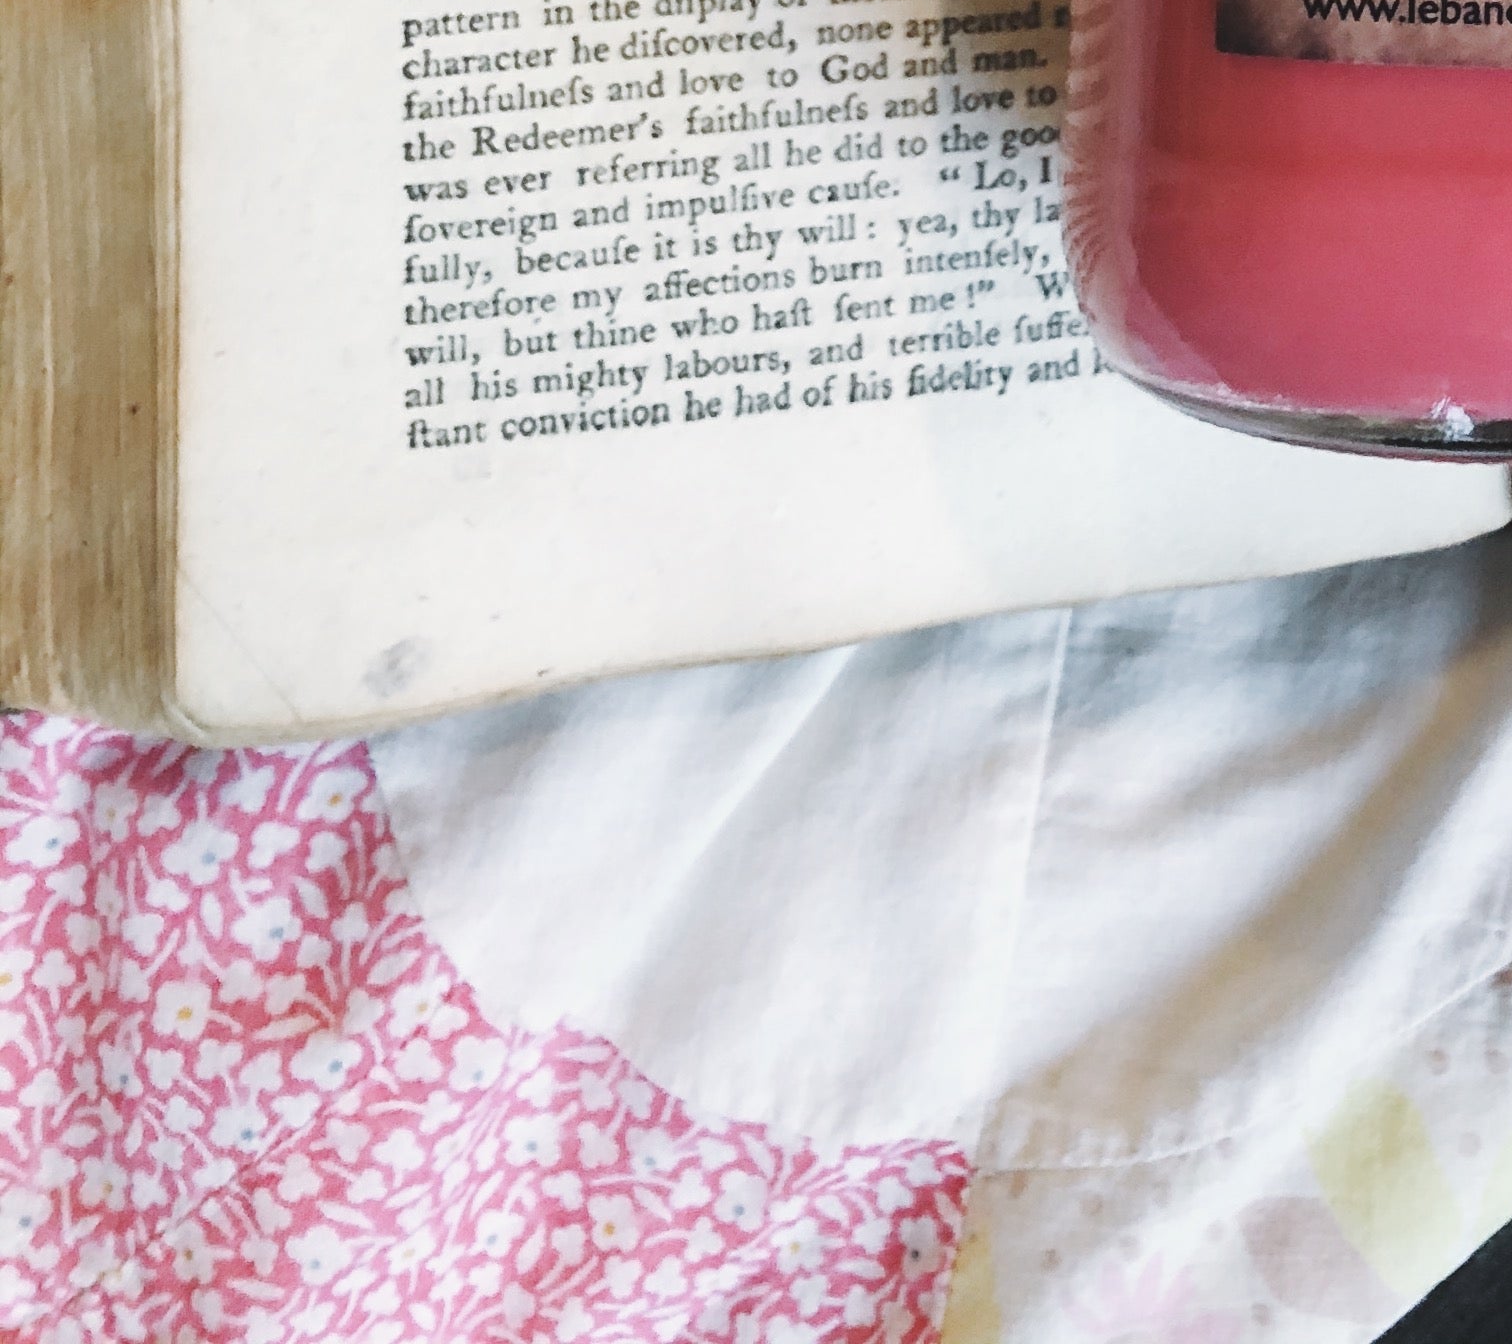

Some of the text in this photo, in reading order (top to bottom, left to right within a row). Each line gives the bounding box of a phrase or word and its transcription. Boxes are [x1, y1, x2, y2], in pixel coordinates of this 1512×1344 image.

[401, 131, 456, 163] the
[884, 87, 939, 120] and
[951, 84, 1015, 114] love
[1025, 84, 1062, 108] to
[402, 123, 989, 202] was ever referring all he did to the
[404, 319, 1001, 410] all his mighty labours, and terrible
[500, 348, 1080, 442] conviction he had of his fidelity and
